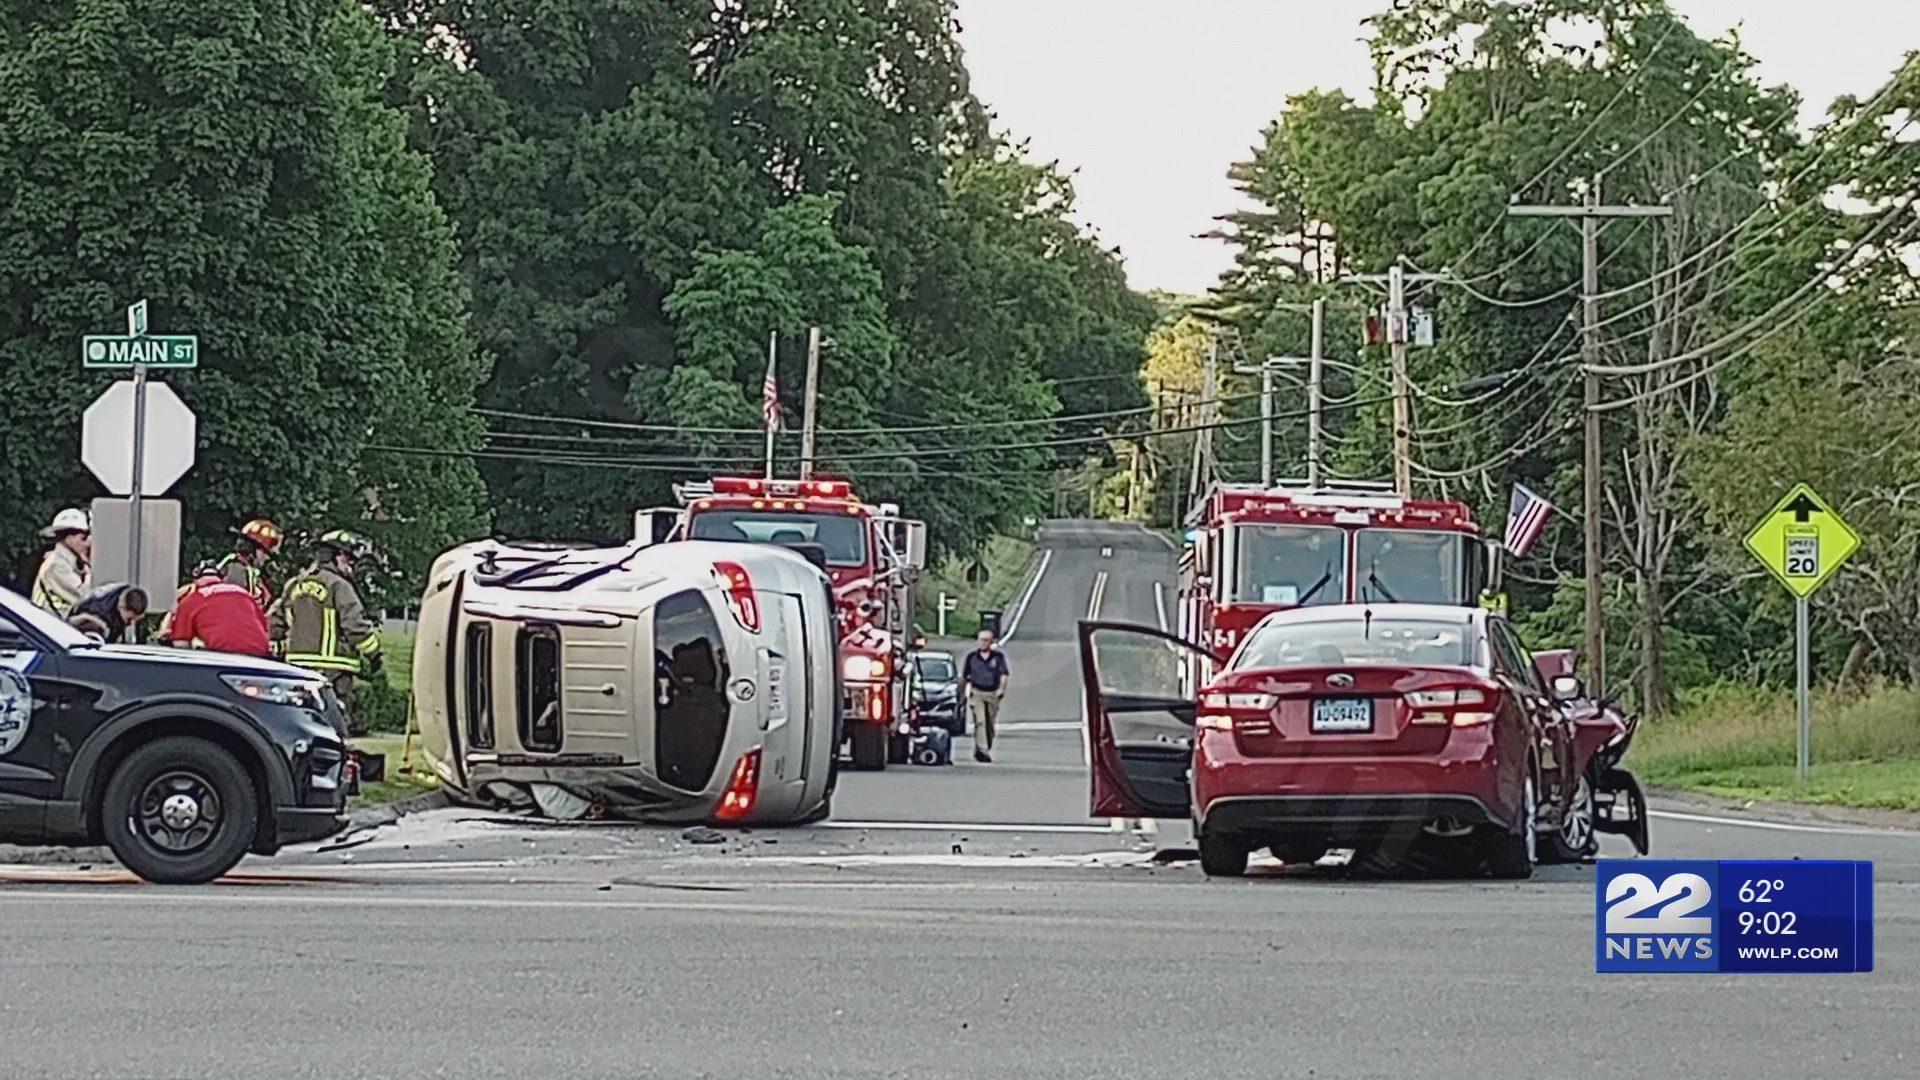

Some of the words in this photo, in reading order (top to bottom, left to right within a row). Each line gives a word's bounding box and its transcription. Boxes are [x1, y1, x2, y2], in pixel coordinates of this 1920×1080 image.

[109, 341, 168, 361] MAIN
[173, 344, 192, 358] ST
[1788, 558, 1815, 573] 20
